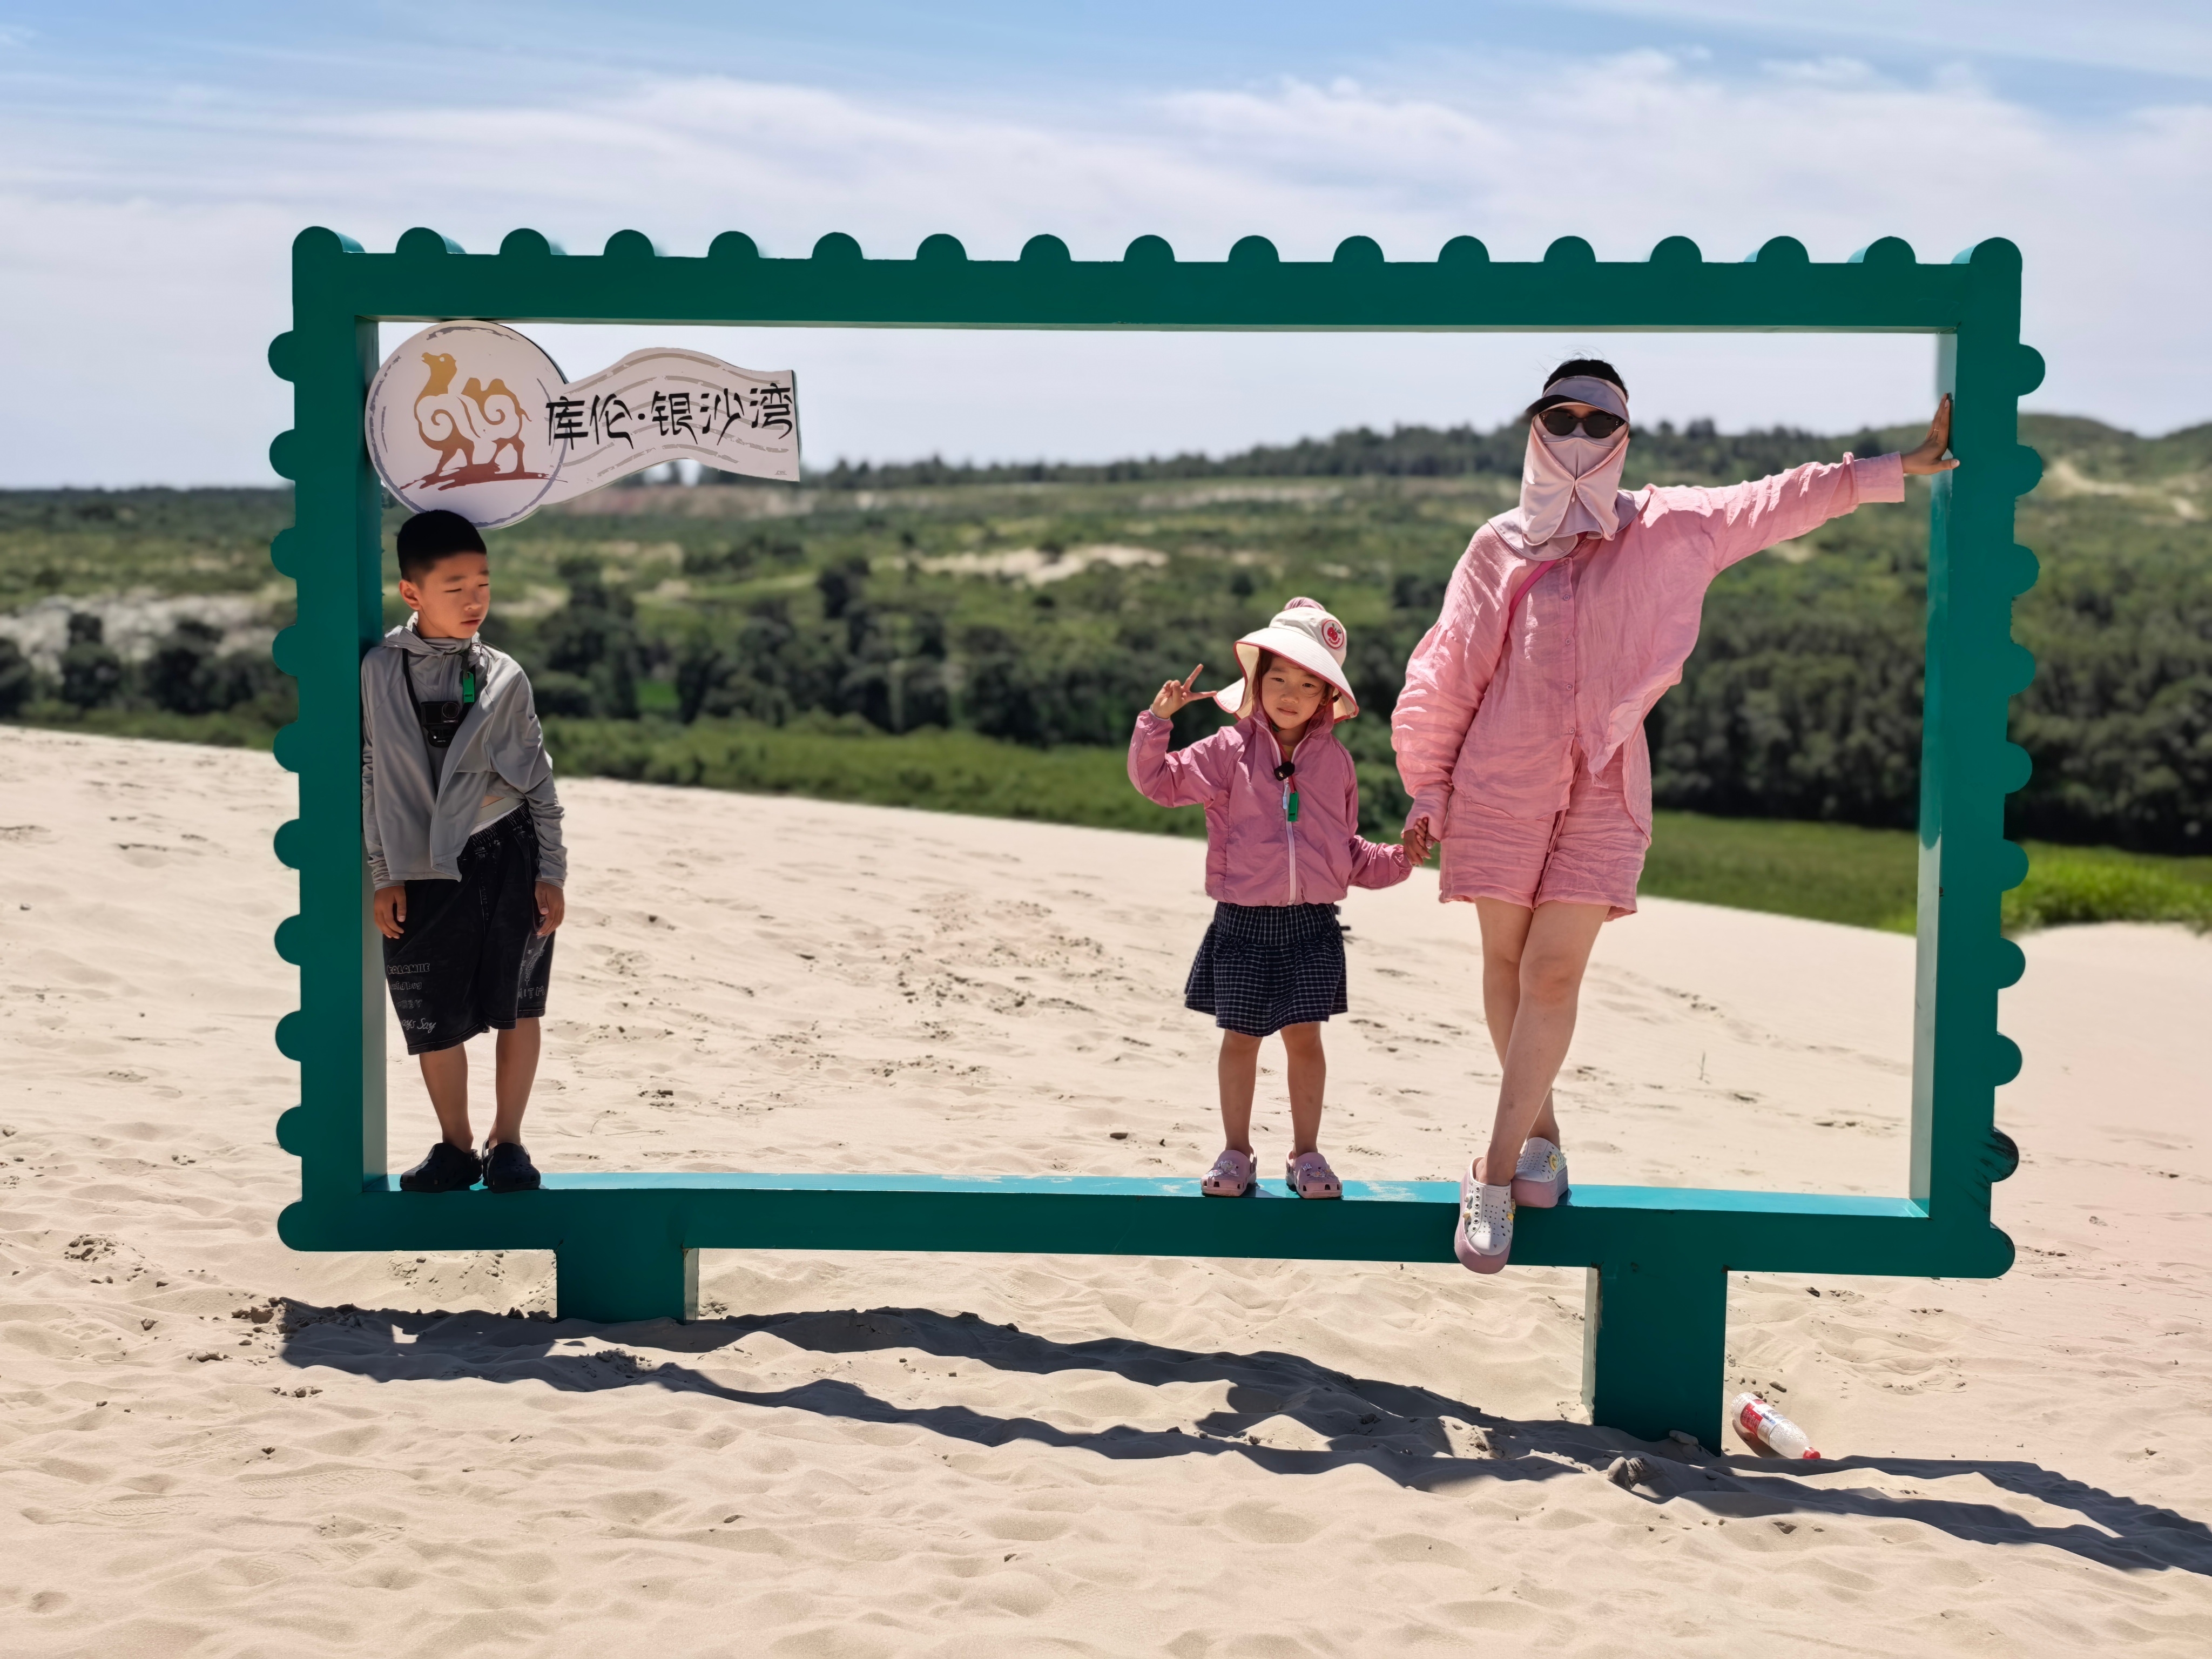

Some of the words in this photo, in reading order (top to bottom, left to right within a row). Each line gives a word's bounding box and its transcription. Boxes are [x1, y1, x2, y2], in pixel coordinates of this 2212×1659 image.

[545, 383, 793, 450] 库伦·银沙湾
